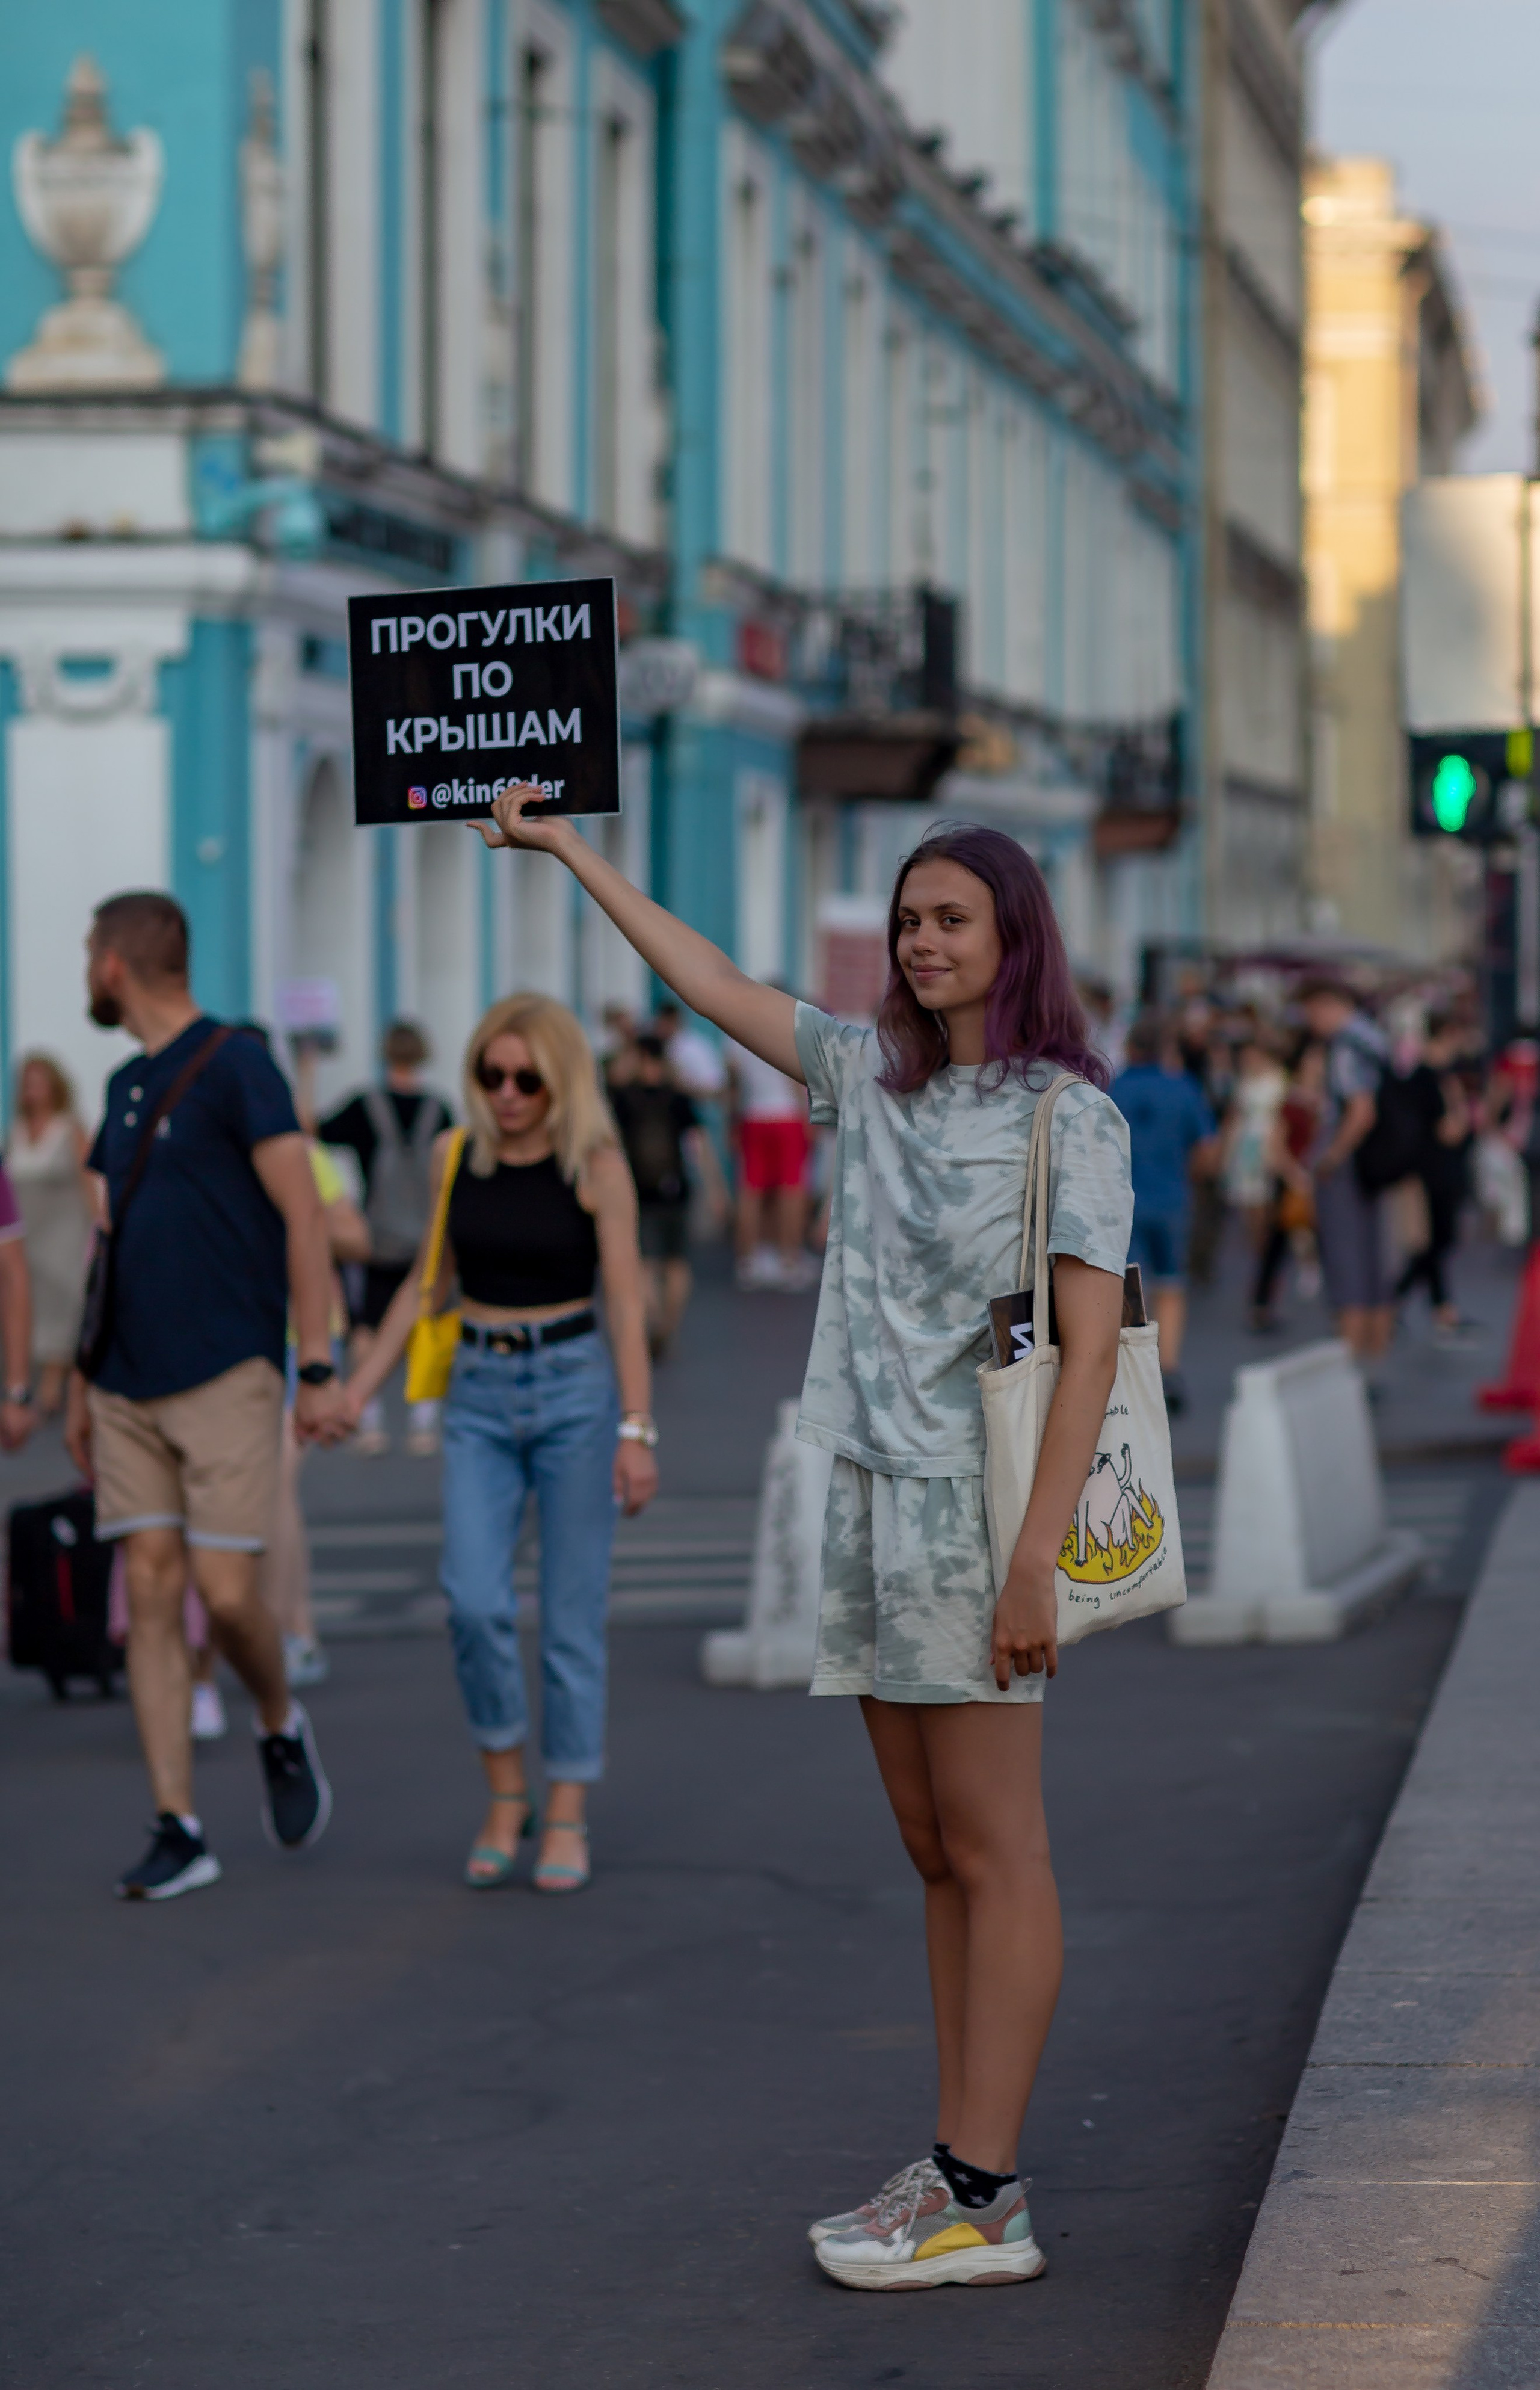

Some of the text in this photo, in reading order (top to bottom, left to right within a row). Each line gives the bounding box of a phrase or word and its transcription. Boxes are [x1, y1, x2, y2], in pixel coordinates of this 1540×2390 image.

[372, 604, 591, 653] ПРОГУЛКИ
[453, 661, 513, 699] ПО
[387, 708, 581, 755] КРЫШАМ
[1068, 1546, 1168, 1610] being uncomfortable
